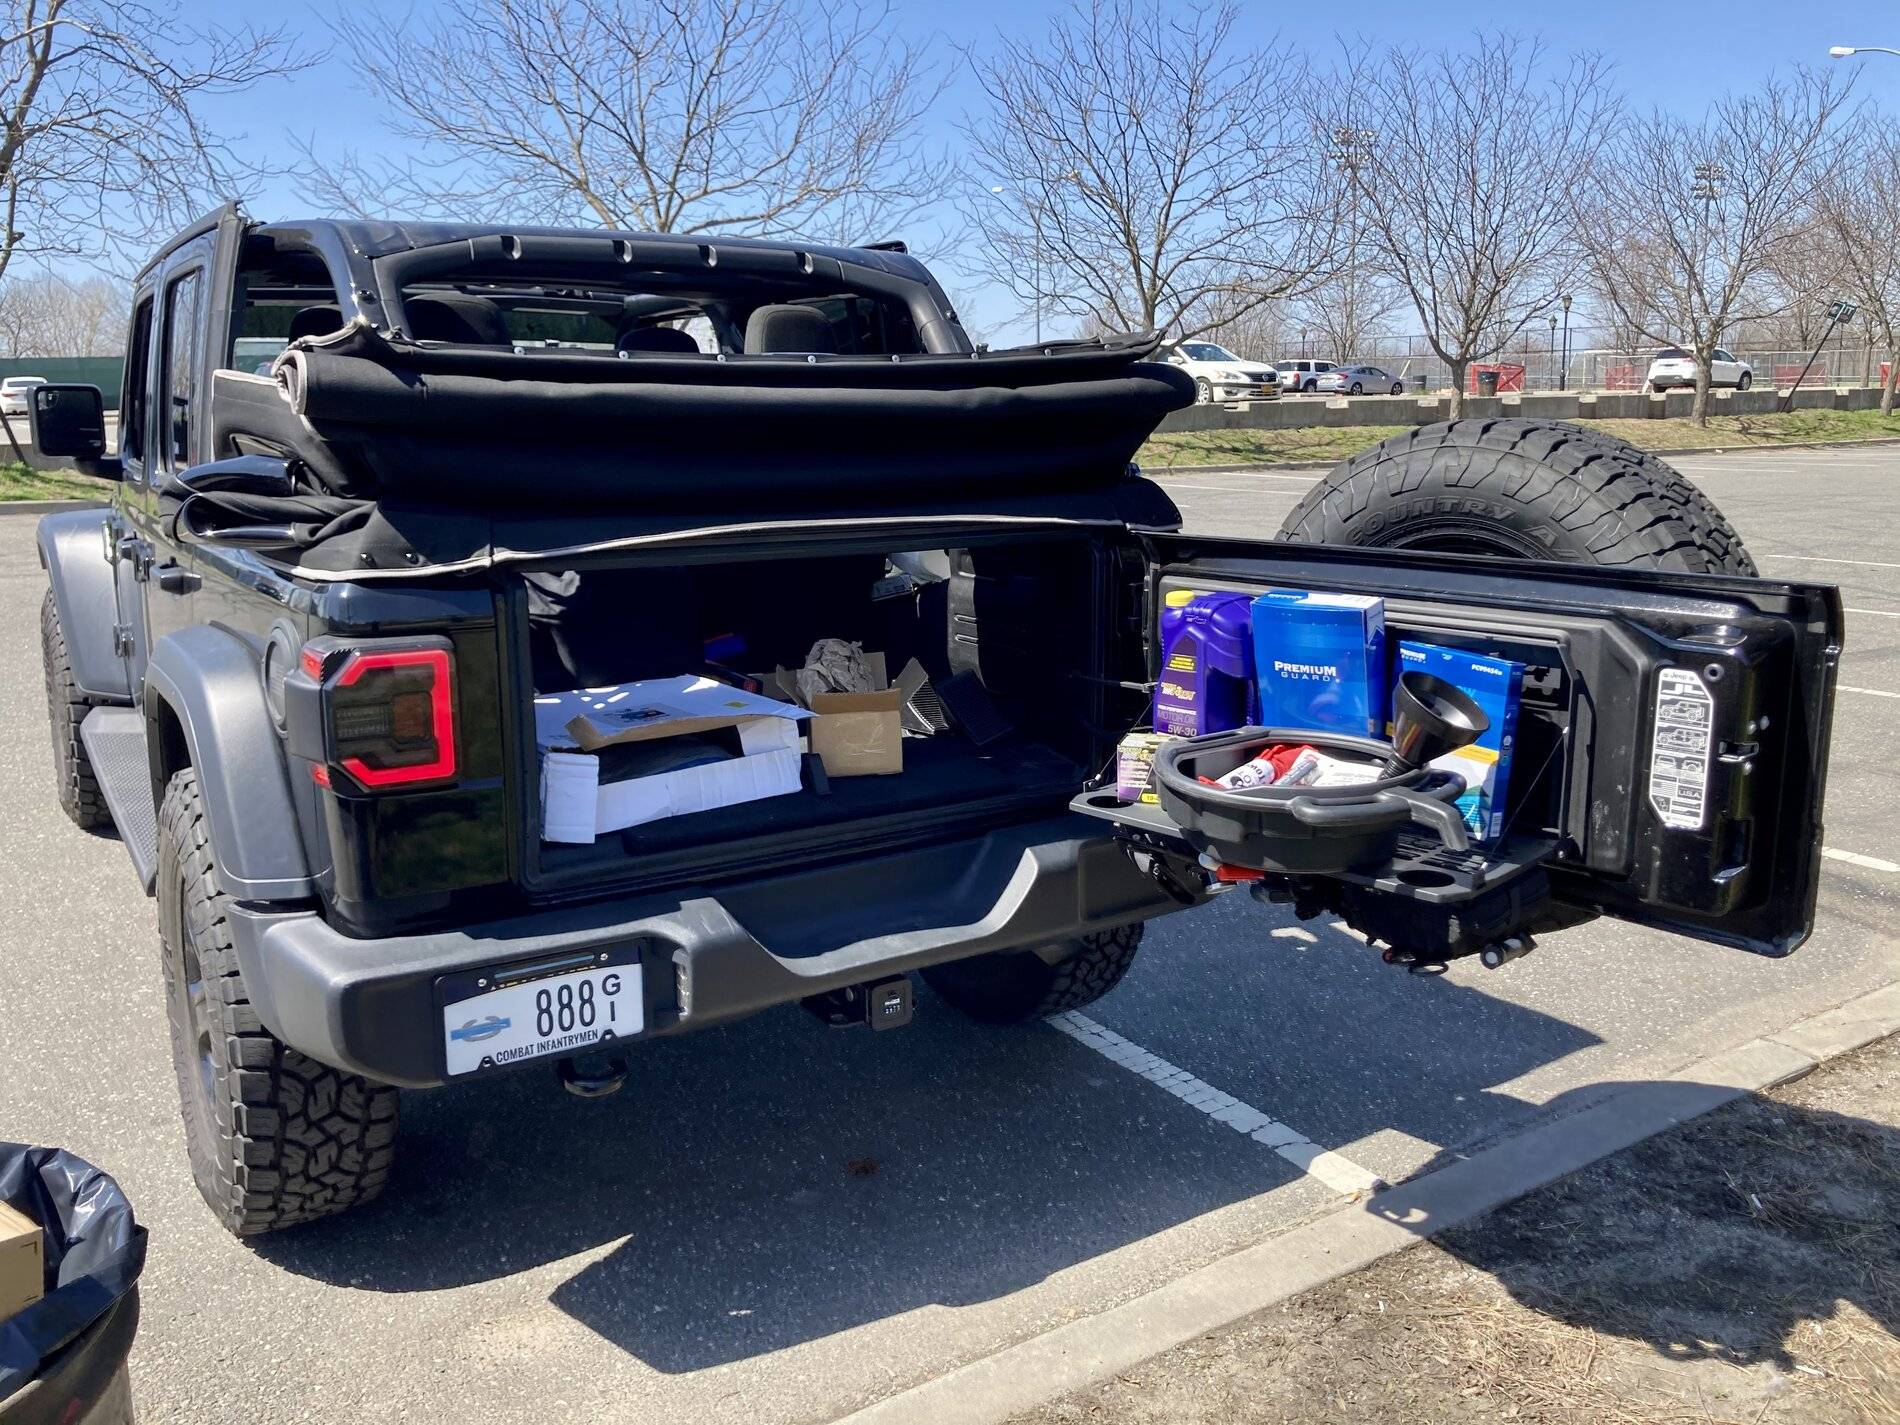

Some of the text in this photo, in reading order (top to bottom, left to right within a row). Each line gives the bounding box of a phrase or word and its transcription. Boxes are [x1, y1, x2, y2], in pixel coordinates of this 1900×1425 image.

[1345, 496, 1516, 545] COUNTRY
[1274, 660, 1337, 677] PREMIUM
[1281, 671, 1331, 682] GUARD
[1678, 789, 1701, 799] USA
[536, 979, 596, 1037] 888
[496, 1029, 599, 1063] COMBAT INFANTRYMEN
